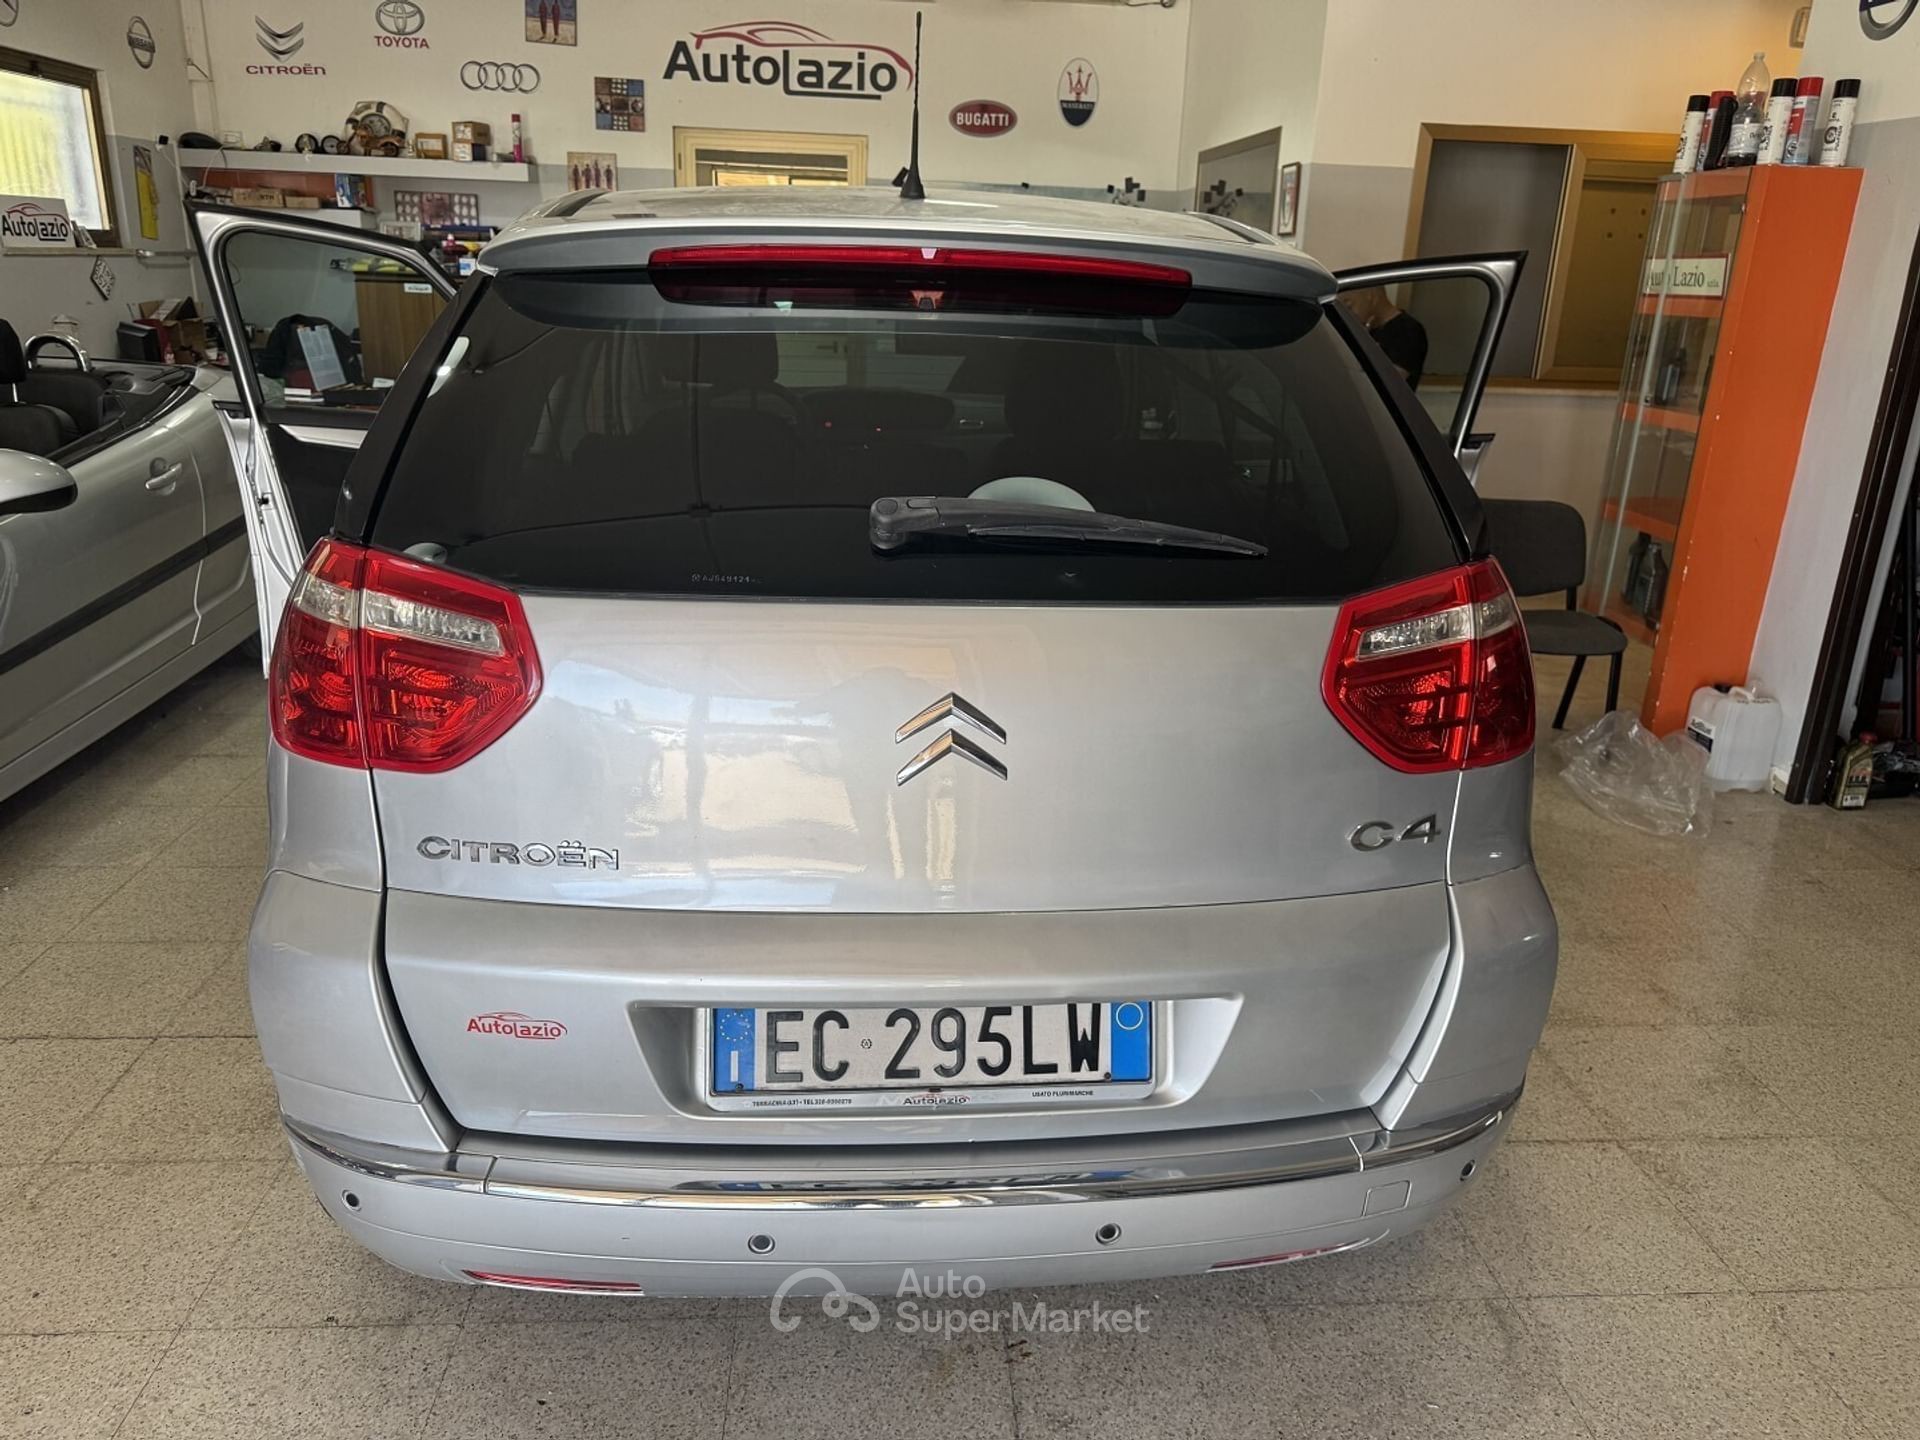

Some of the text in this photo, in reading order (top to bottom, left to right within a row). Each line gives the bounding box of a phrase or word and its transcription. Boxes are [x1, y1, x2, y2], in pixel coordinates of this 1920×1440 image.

[374, 36, 430, 49] TOYOTA
[956, 112, 1010, 127] BUGATTI
[1673, 265, 1705, 288] Lazio
[1346, 813, 1442, 852] C4
[416, 835, 619, 871] CITROËN
[765, 1002, 1101, 1084] EC 295LW
